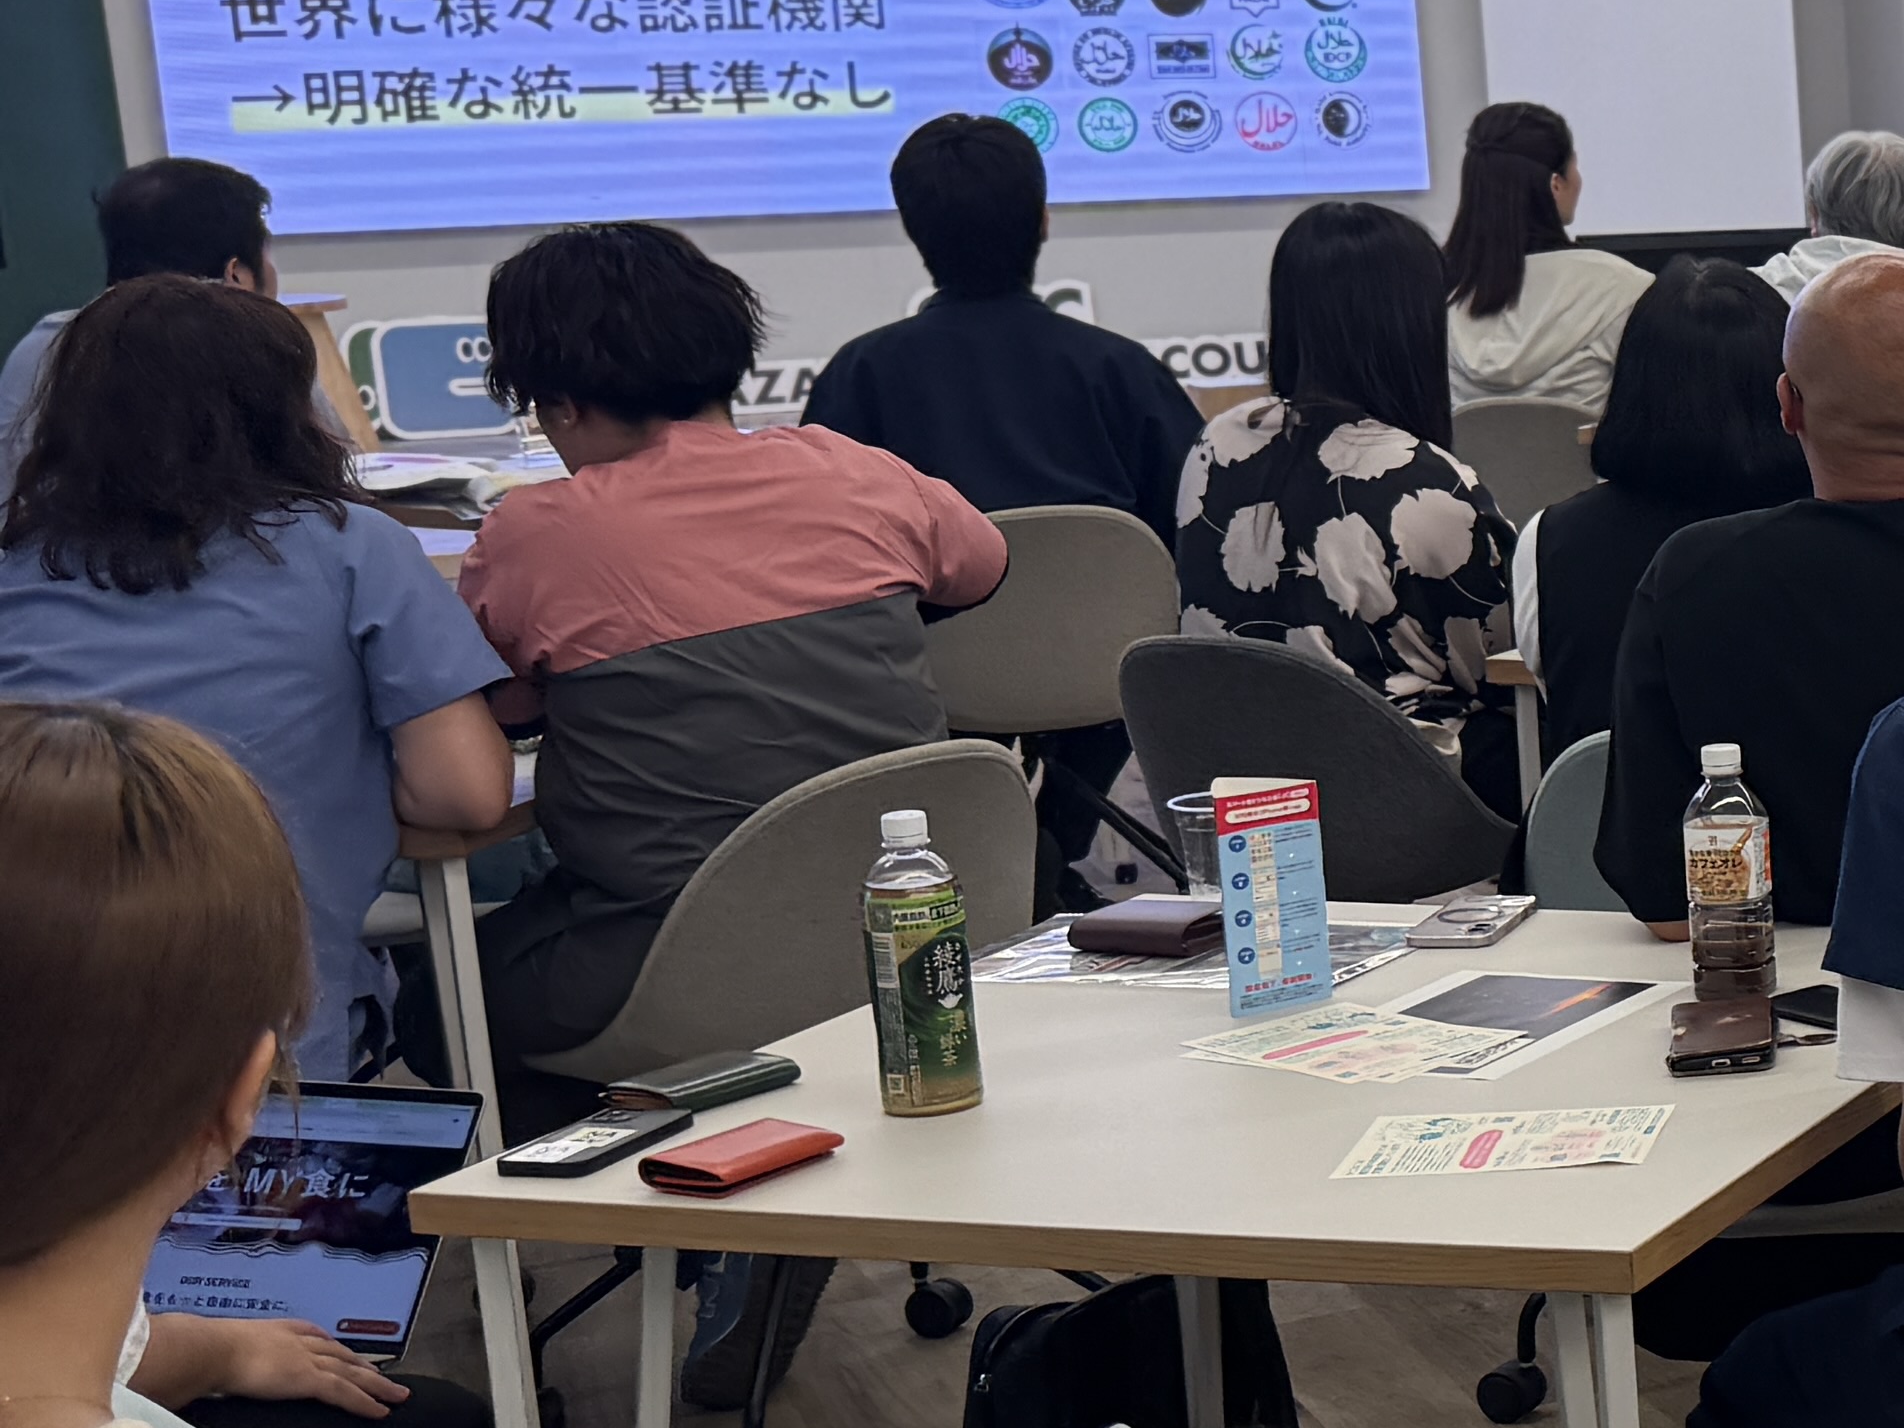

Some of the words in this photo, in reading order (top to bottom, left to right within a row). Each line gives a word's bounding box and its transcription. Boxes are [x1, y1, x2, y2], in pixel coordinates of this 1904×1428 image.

[303, 59, 892, 126] 明確な統一基準なし
